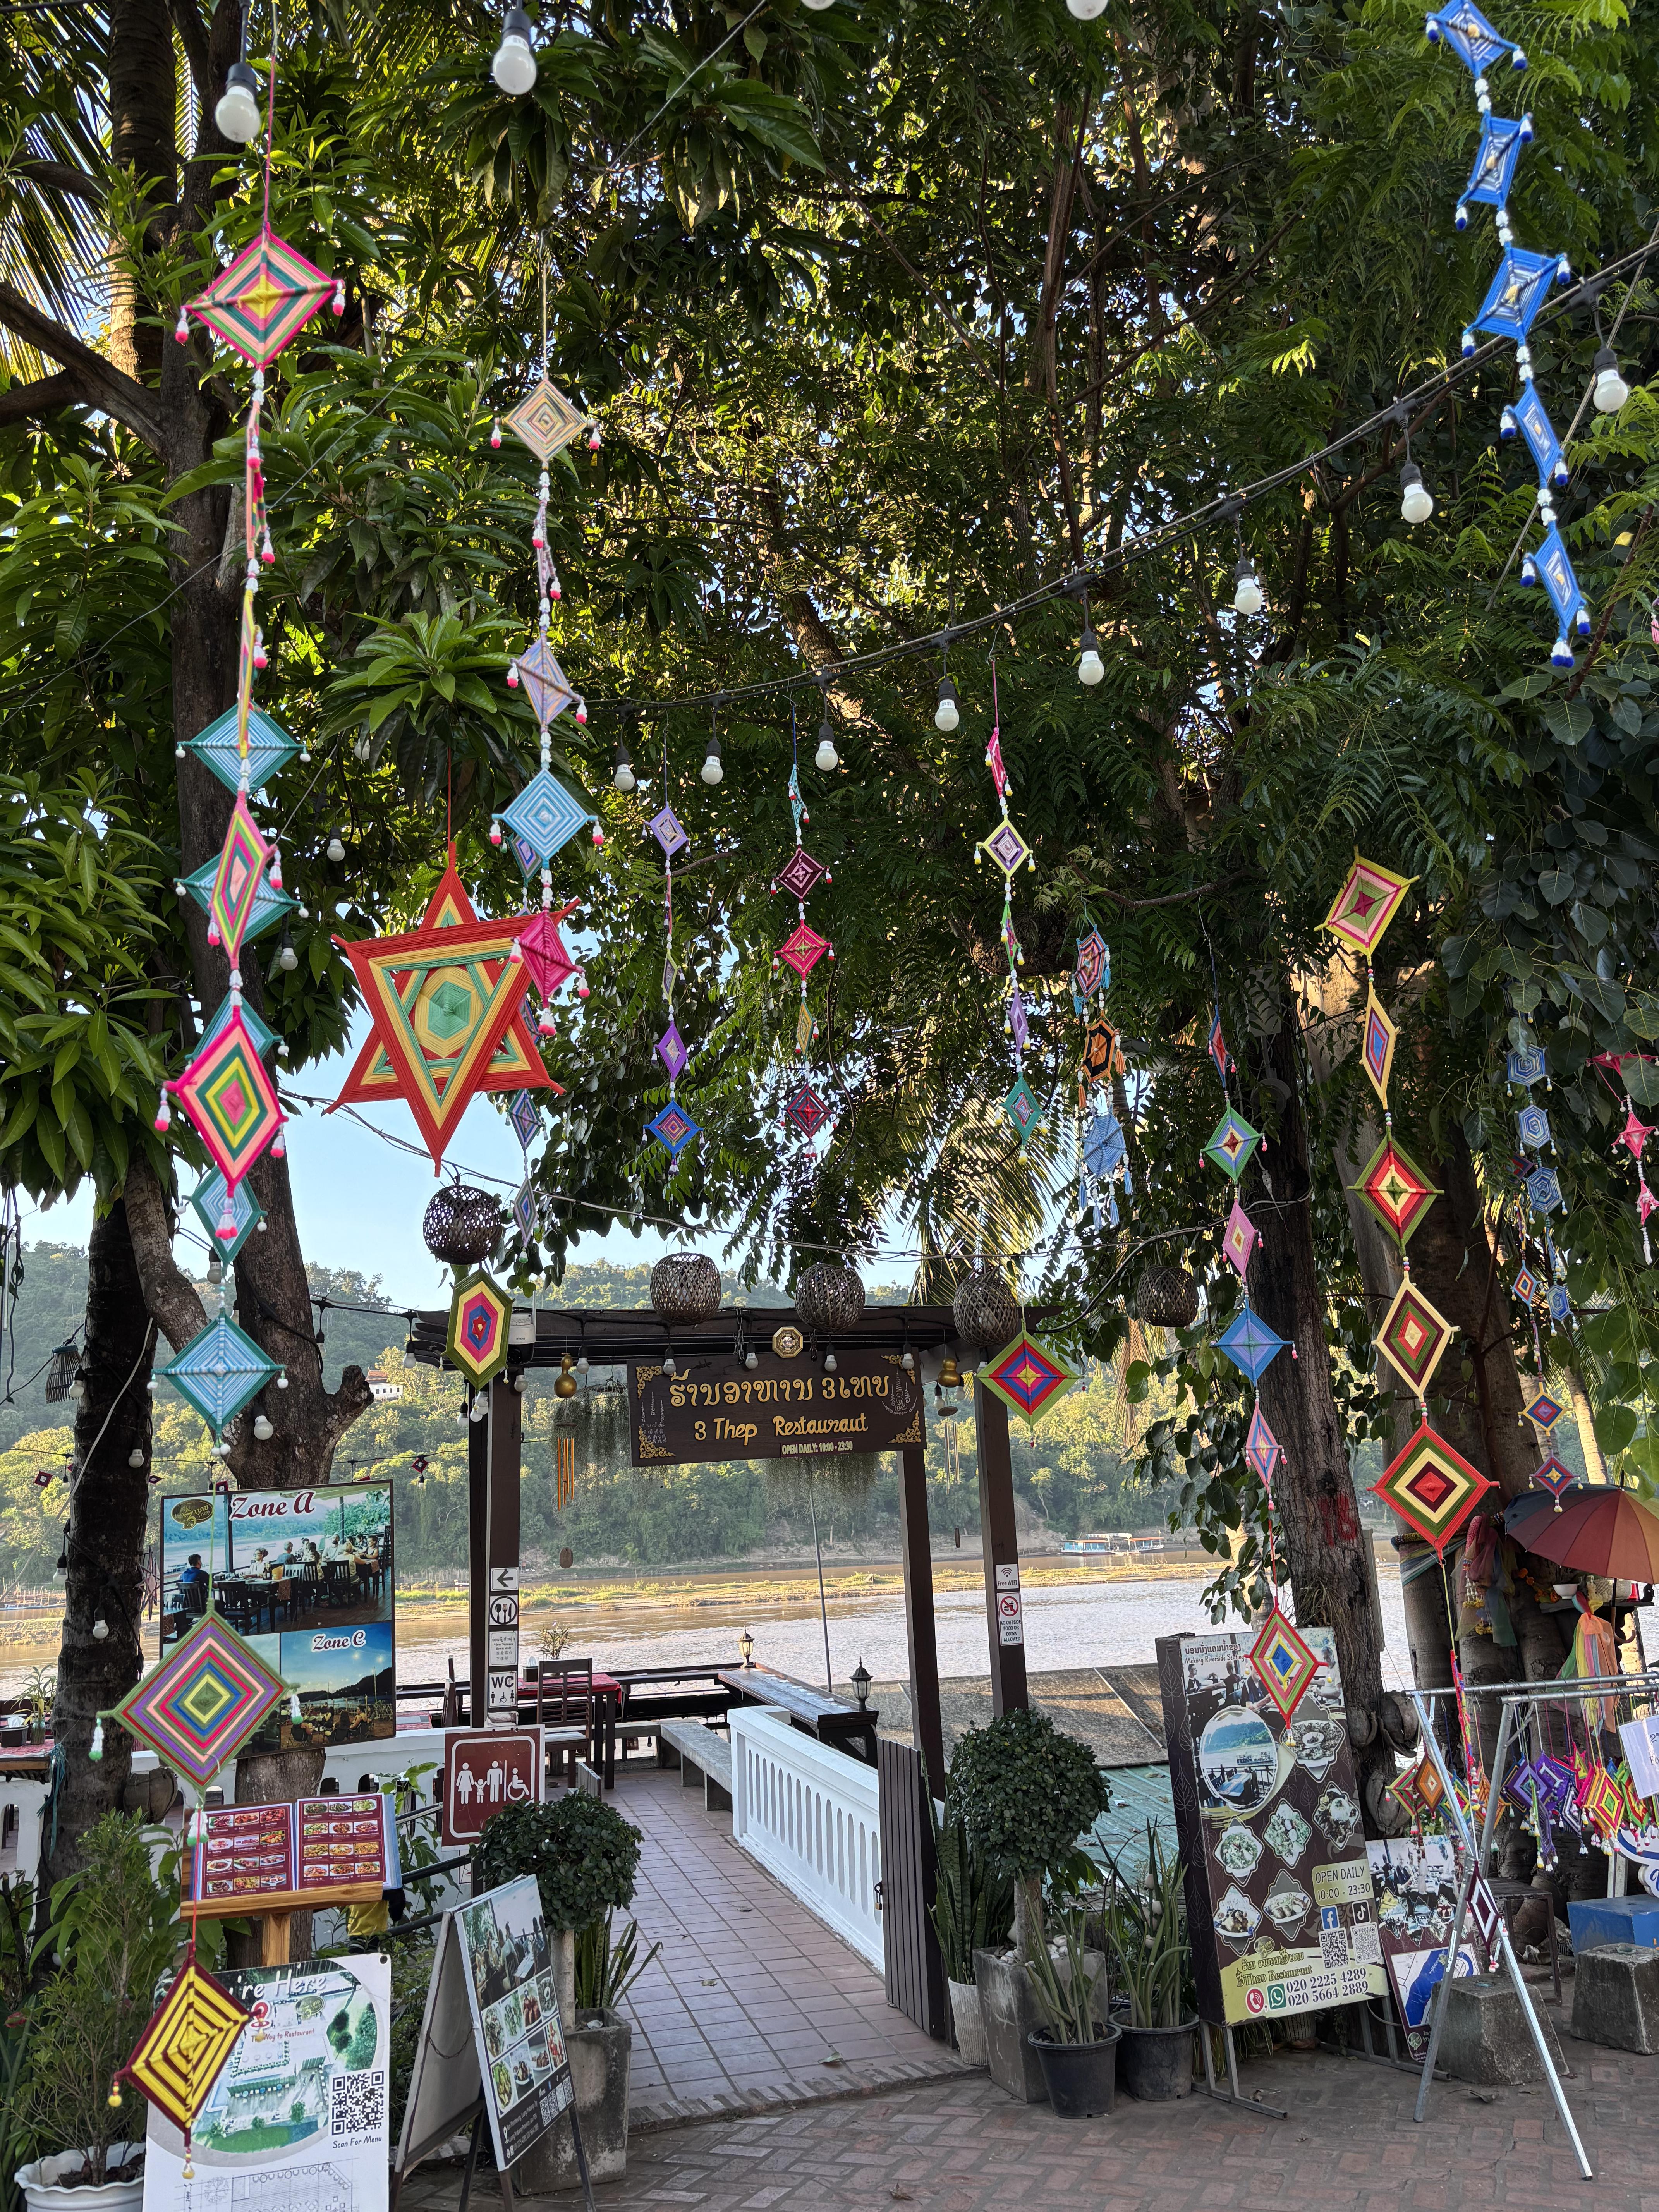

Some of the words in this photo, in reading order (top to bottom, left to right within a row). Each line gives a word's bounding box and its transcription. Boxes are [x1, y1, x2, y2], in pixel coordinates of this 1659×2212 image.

[695, 1421, 706, 1440] 3
[713, 1417, 757, 1446] Thep
[782, 1444, 798, 1455] OPEN
[799, 1443, 818, 1453] DAILY:
[819, 1442, 834, 1452] 10:00
[838, 1441, 853, 1451] 23:30
[231, 1497, 288, 1519] Zone
[294, 1492, 315, 1514] A
[313, 1636, 349, 1650] Zone
[353, 1632, 364, 1645] C
[1185, 1657, 1203, 1665] Mekong
[1205, 1654, 1225, 1662] Riverside
[491, 1675, 514, 1688] WC
[1316, 1870, 1338, 1883] OPEN
[1341, 1865, 1364, 1879] DAILY
[1318, 1888, 1339, 1900] 10:00
[1348, 1883, 1370, 1895] 23:30
[1268, 1965, 1313, 1982] Restaurant
[1286, 1979, 1307, 1993] 020
[1310, 1973, 1337, 1989] 2225
[1340, 1967, 1366, 1983] 4289
[275, 1969, 326, 1996] Here
[1288, 1992, 1309, 2007] 020
[1313, 1986, 1339, 2002] 5664
[1342, 1981, 1368, 1996] 2889
[285, 2028, 314, 2038] Restaurant
[333, 2140, 348, 2148] Scan
[350, 2138, 361, 2146] For
[363, 2135, 382, 2144] Menu
